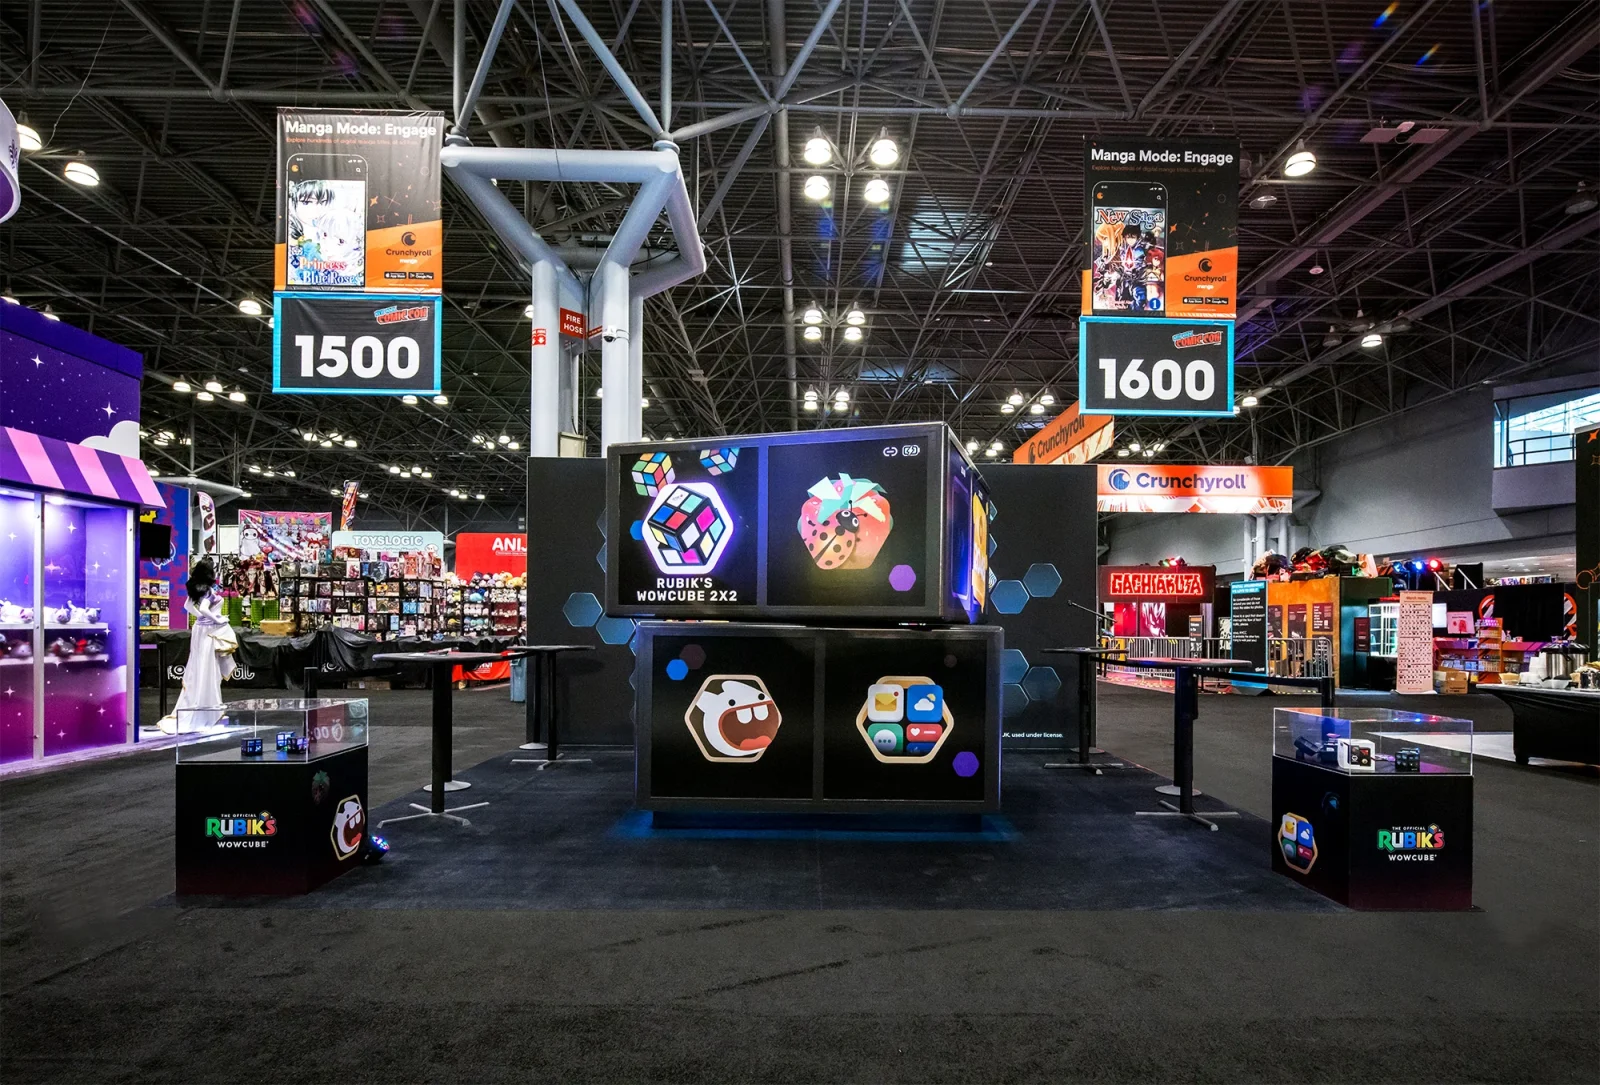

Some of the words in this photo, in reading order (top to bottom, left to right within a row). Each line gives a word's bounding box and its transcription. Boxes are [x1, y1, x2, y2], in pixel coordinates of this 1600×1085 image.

[286, 121, 332, 136] Manga
[337, 122, 380, 135] Mode:
[385, 124, 436, 138] Engage
[1092, 148, 1136, 164] Manga
[1140, 150, 1180, 162] Mode:
[1184, 151, 1234, 166] Engage
[1096, 209, 1128, 224] New
[386, 249, 432, 257] Crunchyroll
[300, 257, 346, 270] Princess
[1184, 275, 1226, 283] Crunchyroll
[566, 314, 580, 324] FIRE
[564, 323, 583, 334] HOSE
[1176, 334, 1203, 347] COMIC
[1203, 332, 1222, 344] CON
[295, 335, 420, 378] 1500
[1099, 358, 1215, 400] 1600
[1038, 414, 1084, 458] Crunchyroll
[1136, 472, 1246, 492] Crunchyroll
[353, 536, 423, 546] TOYSLOGIC
[656, 578, 712, 589] RUBIK'S
[636, 590, 705, 601] WOWCUBE
[710, 590, 738, 601] 2X2
